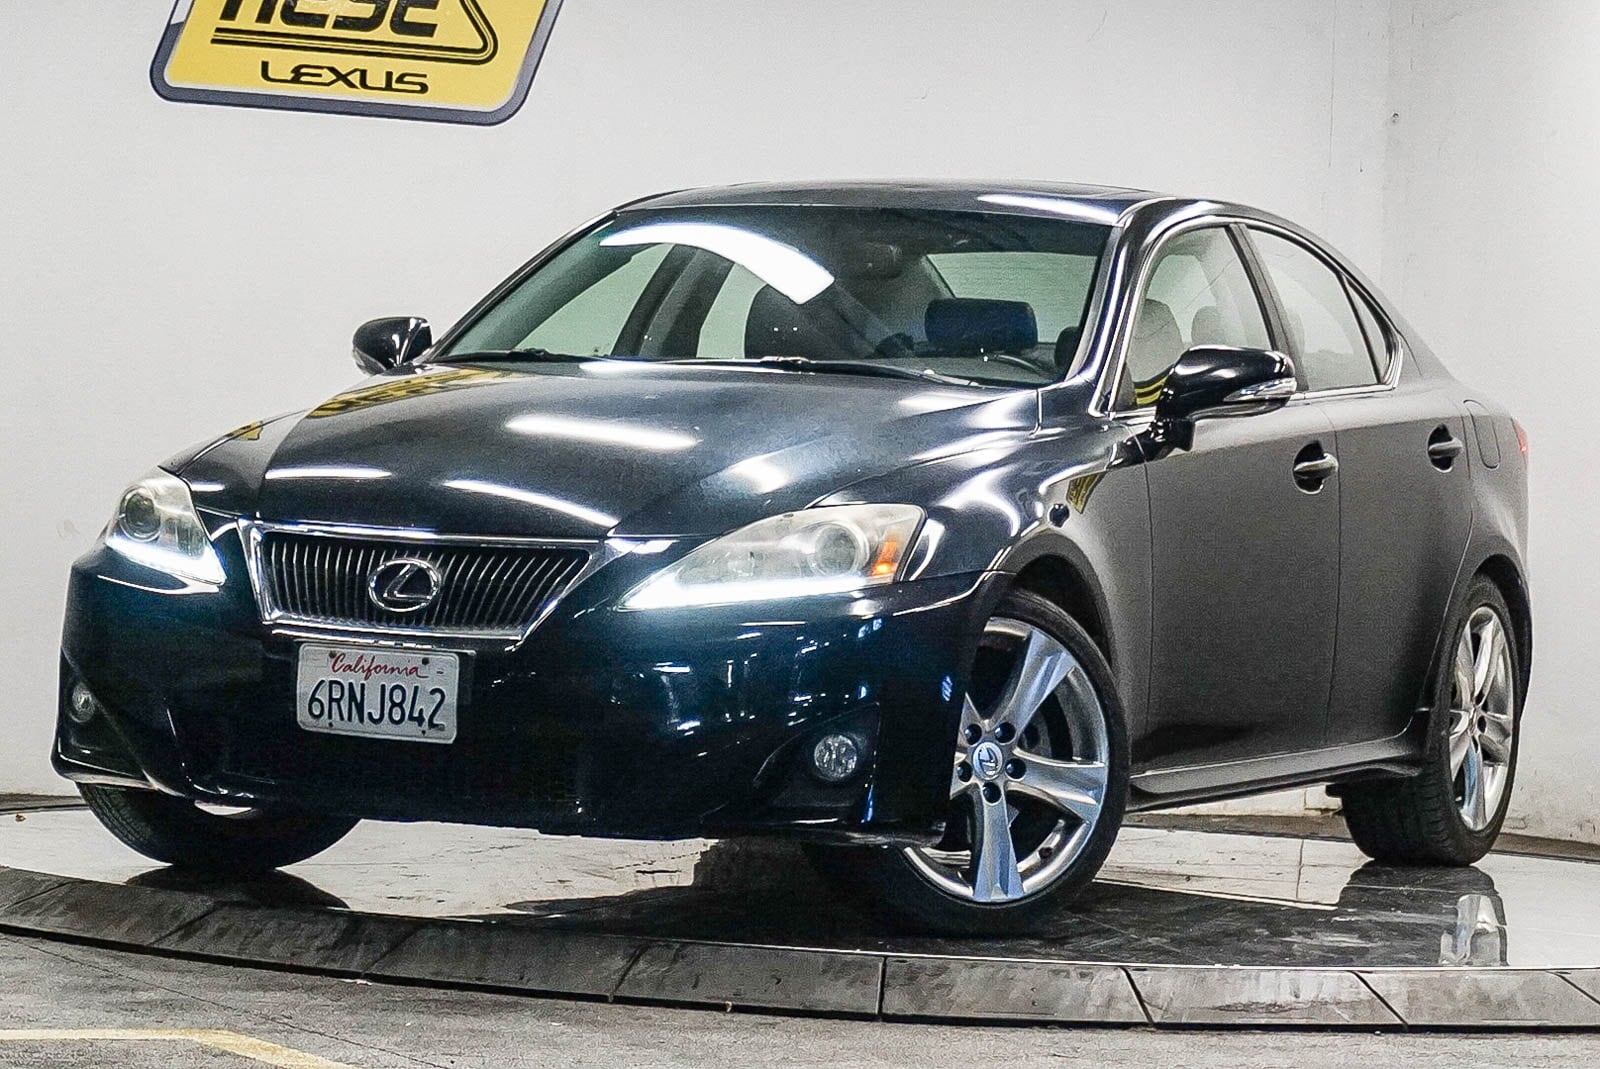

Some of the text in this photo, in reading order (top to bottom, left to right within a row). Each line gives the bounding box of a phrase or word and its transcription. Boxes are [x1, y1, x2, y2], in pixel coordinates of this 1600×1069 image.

[261, 60, 429, 94] LEXUS
[331, 653, 429, 681] California
[307, 679, 446, 731] 6RNJ842
